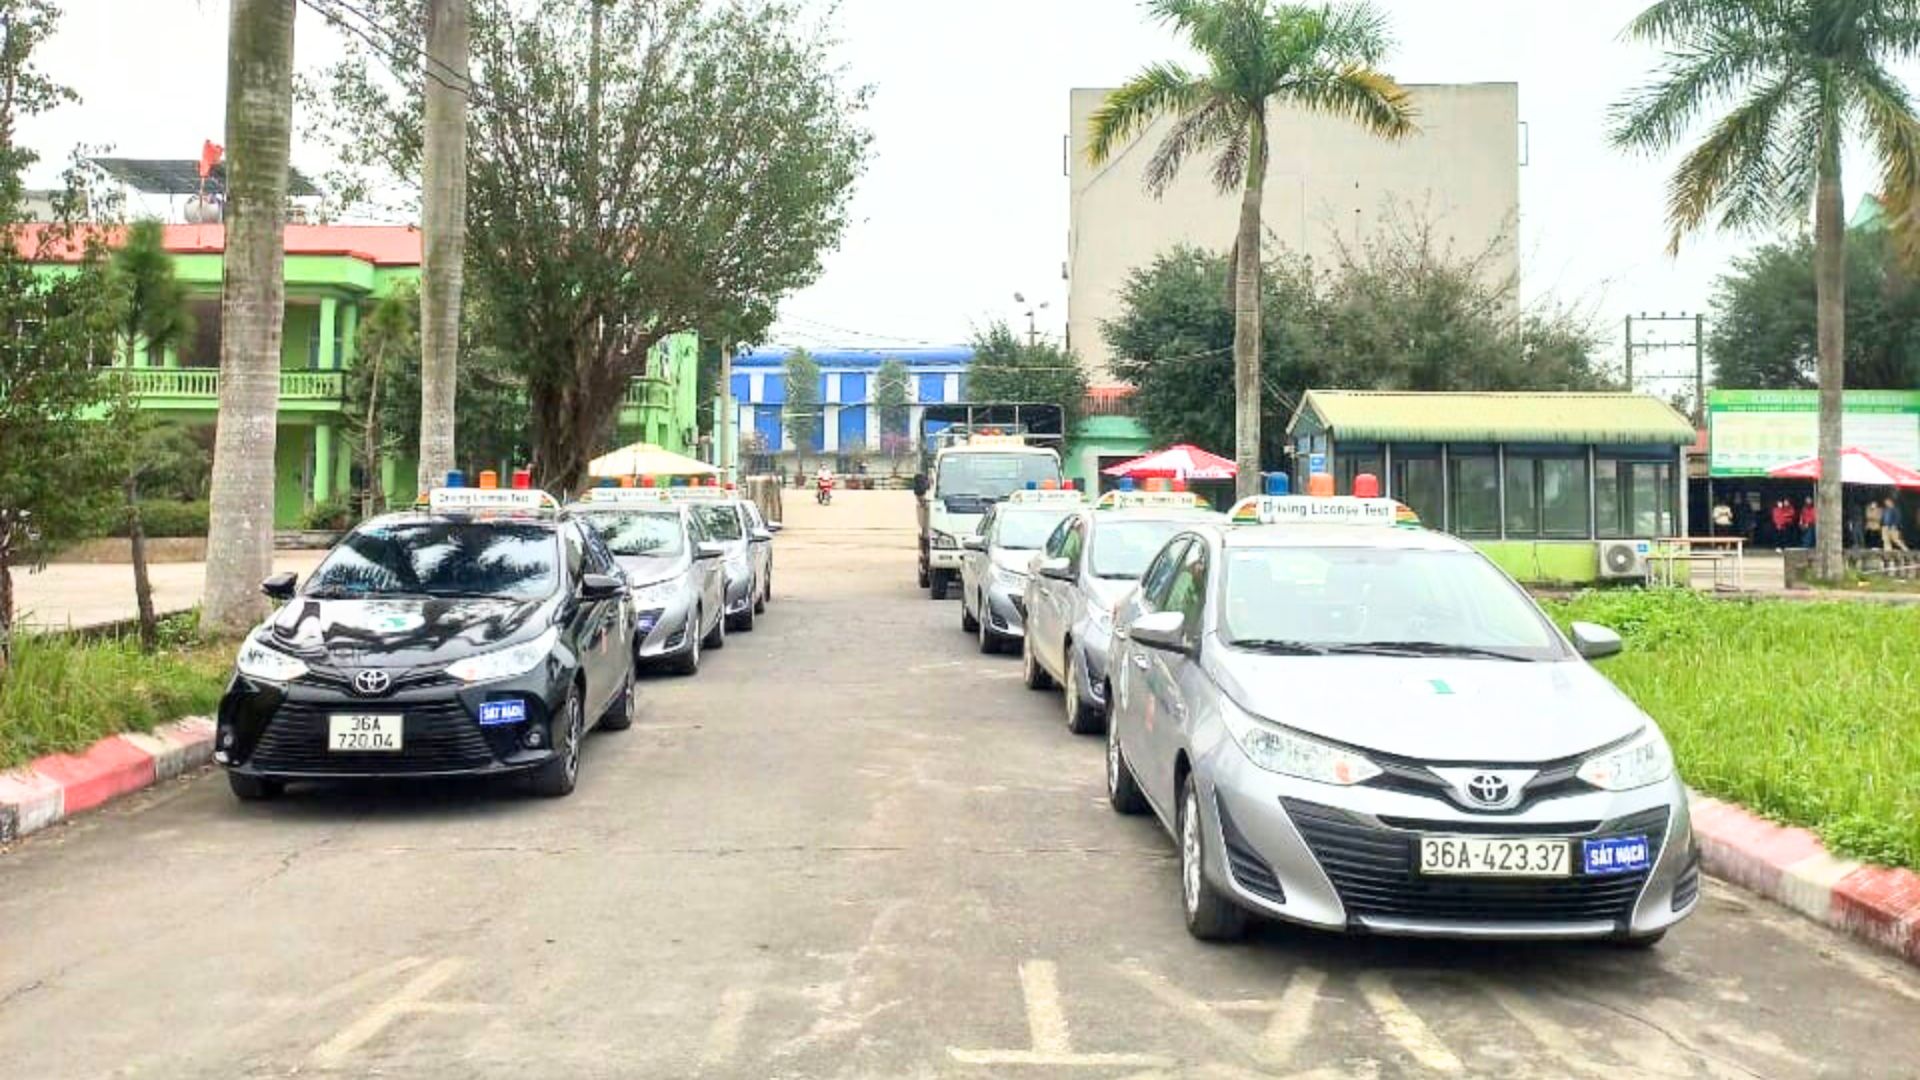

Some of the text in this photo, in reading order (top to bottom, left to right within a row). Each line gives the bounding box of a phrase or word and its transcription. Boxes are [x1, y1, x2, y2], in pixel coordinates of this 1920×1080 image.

[1263, 501, 1307, 517] Driving
[1363, 503, 1389, 517] Test
[351, 716, 381, 731] 36A
[338, 733, 393, 749] 720.04
